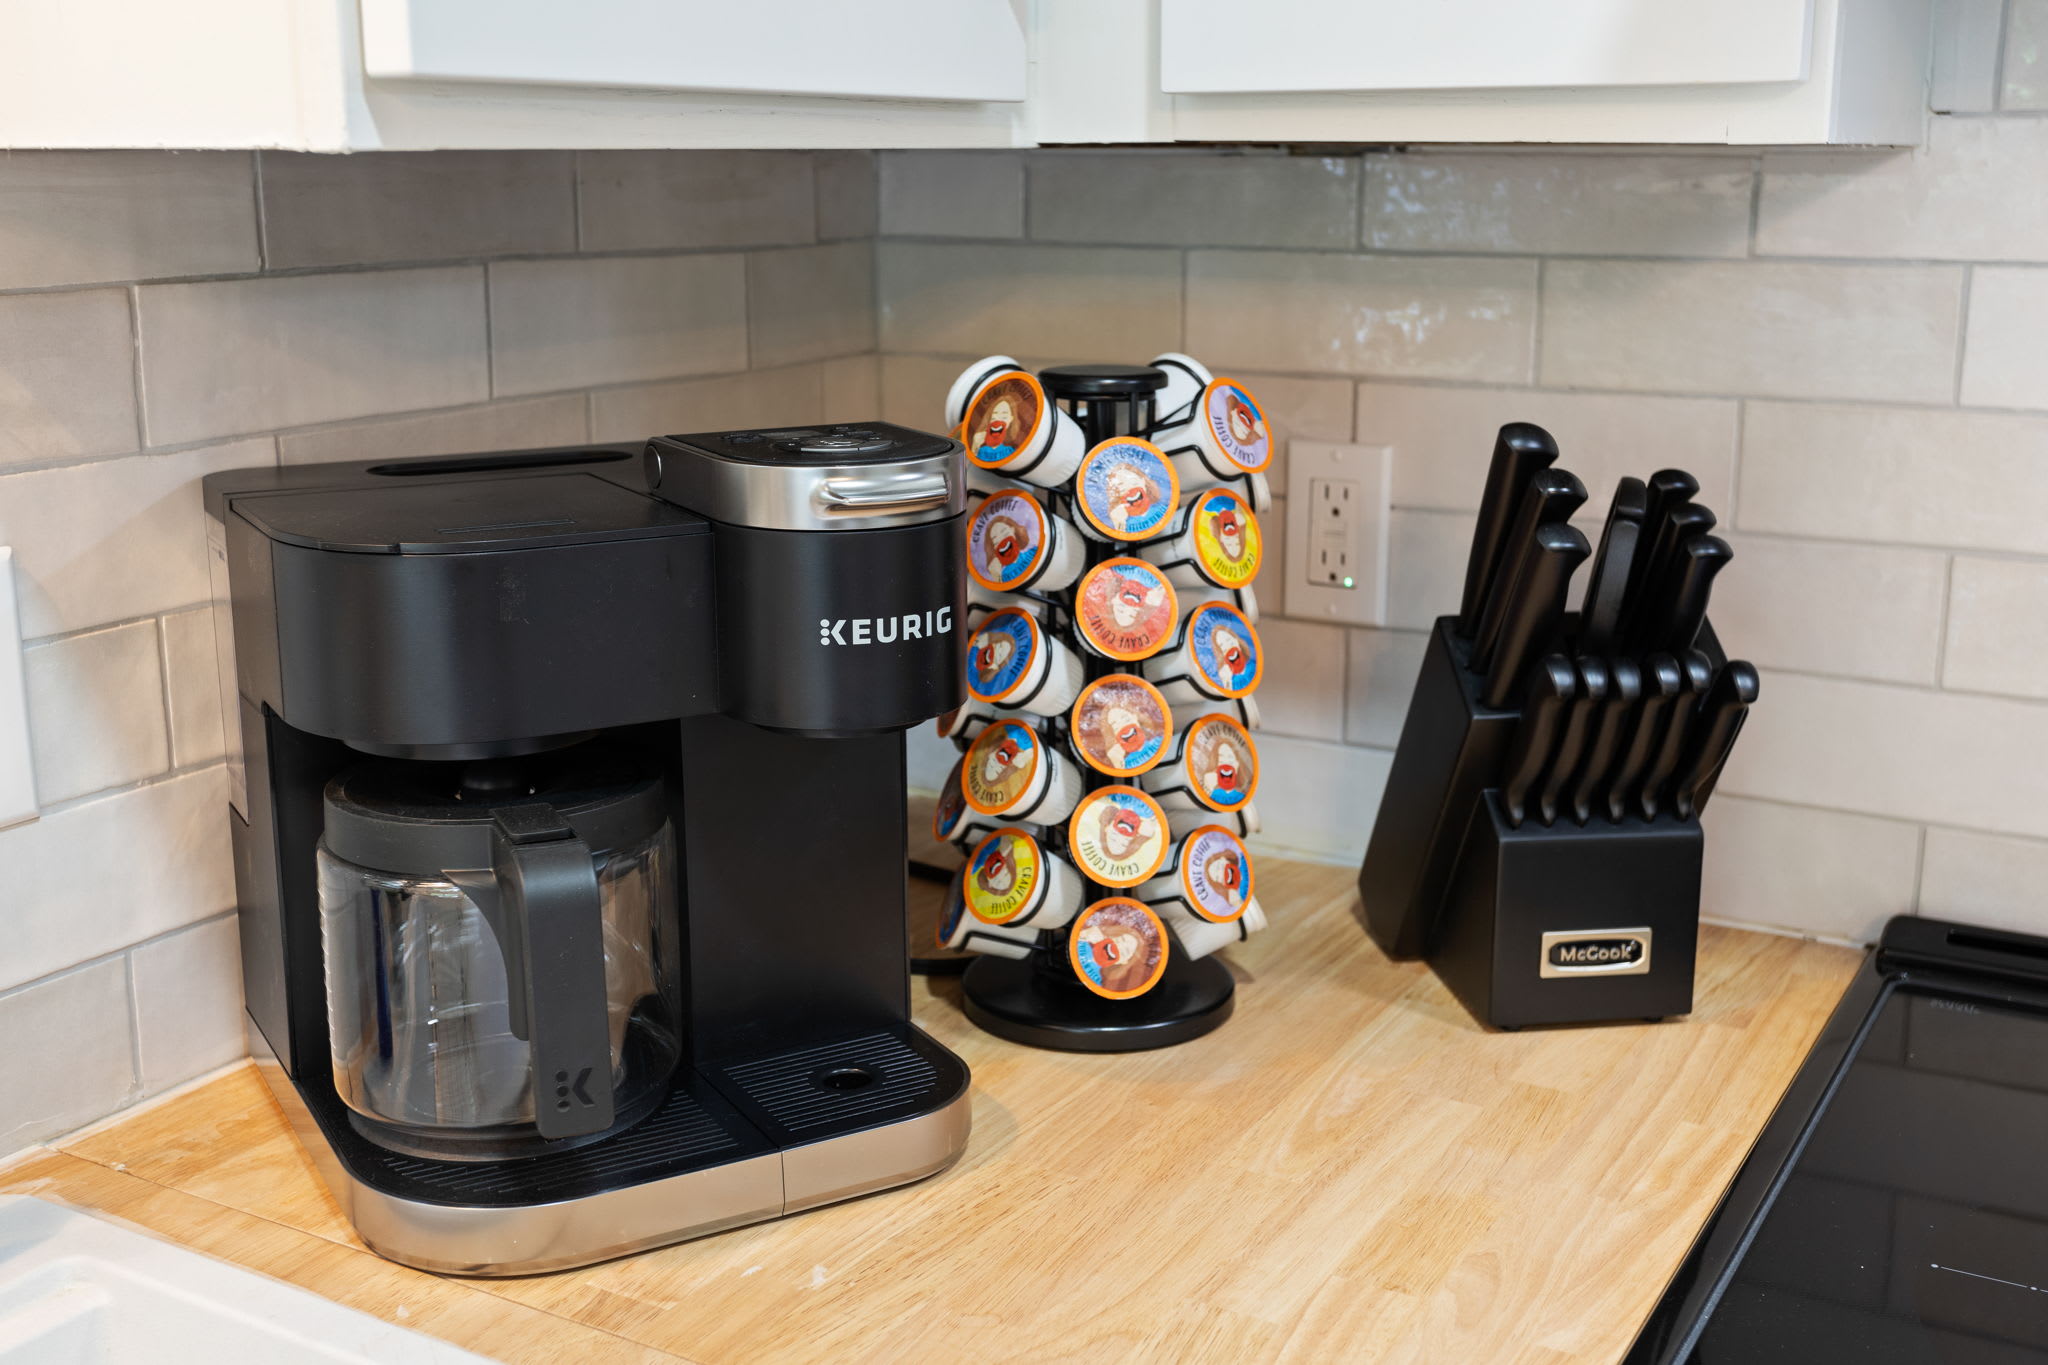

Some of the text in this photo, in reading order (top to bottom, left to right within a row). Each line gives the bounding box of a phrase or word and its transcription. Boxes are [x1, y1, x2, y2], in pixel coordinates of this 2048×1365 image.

[972, 499, 1018, 543] CRAVE COFFEE
[820, 605, 952, 646] KEURIG
[1119, 633, 1150, 648] CRAVE
[980, 790, 1004, 803] CRAVE
[1081, 840, 1140, 876] CRAVE COFFEE
[1016, 866, 1033, 897] CRAVE
[1193, 871, 1209, 901] CRAVE
[1560, 942, 1632, 962] McCook
